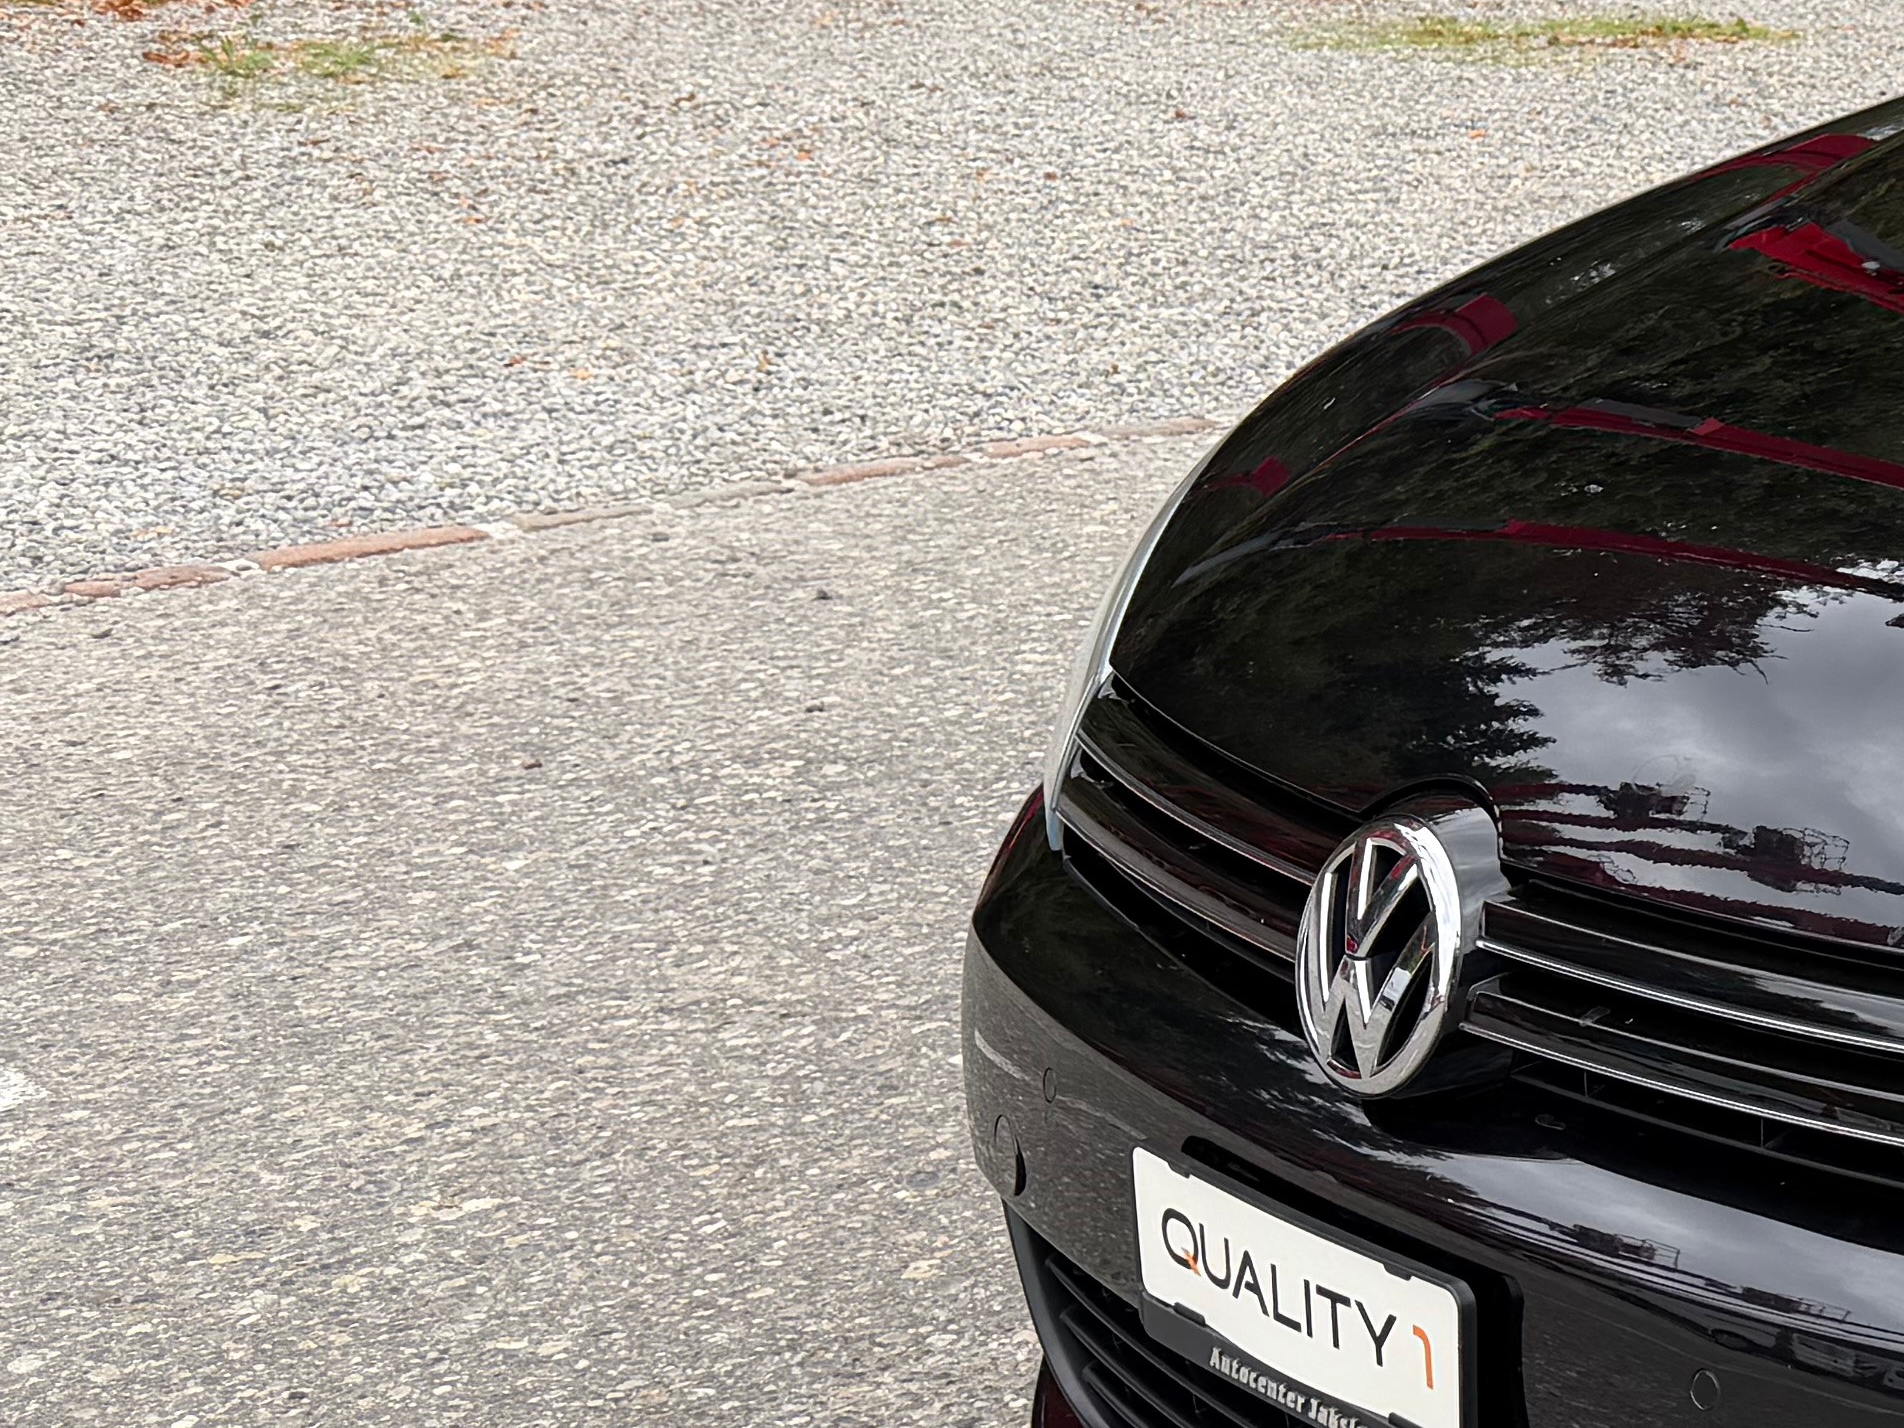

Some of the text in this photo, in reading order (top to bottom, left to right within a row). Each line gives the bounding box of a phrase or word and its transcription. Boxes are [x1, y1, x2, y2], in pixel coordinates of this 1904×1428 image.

[1161, 1207, 1435, 1390] QUALITY 1
[1208, 1346, 1305, 1413] Autocenter
